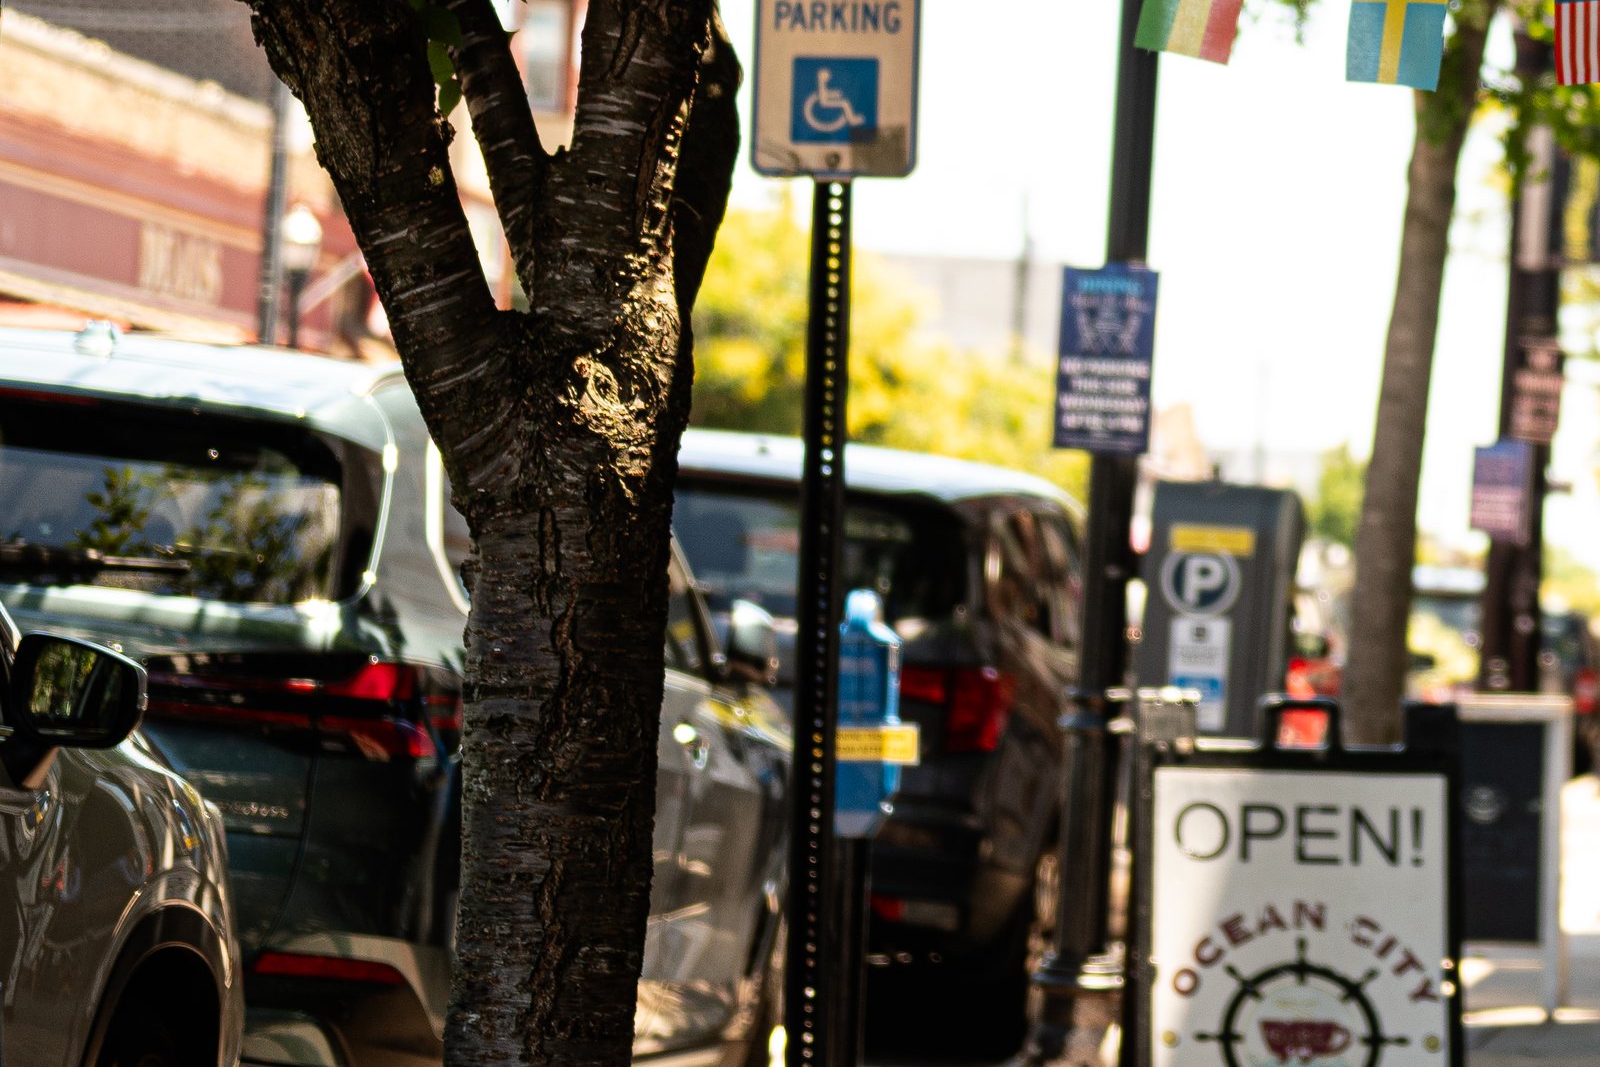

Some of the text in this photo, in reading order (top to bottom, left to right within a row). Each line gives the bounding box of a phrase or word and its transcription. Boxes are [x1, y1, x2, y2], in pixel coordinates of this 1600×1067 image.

[773, 0, 903, 35] PARKING
[1182, 555, 1225, 608] P
[1174, 801, 1425, 867] OPEN!
[1174, 900, 1440, 1003] OCEAN CITY
